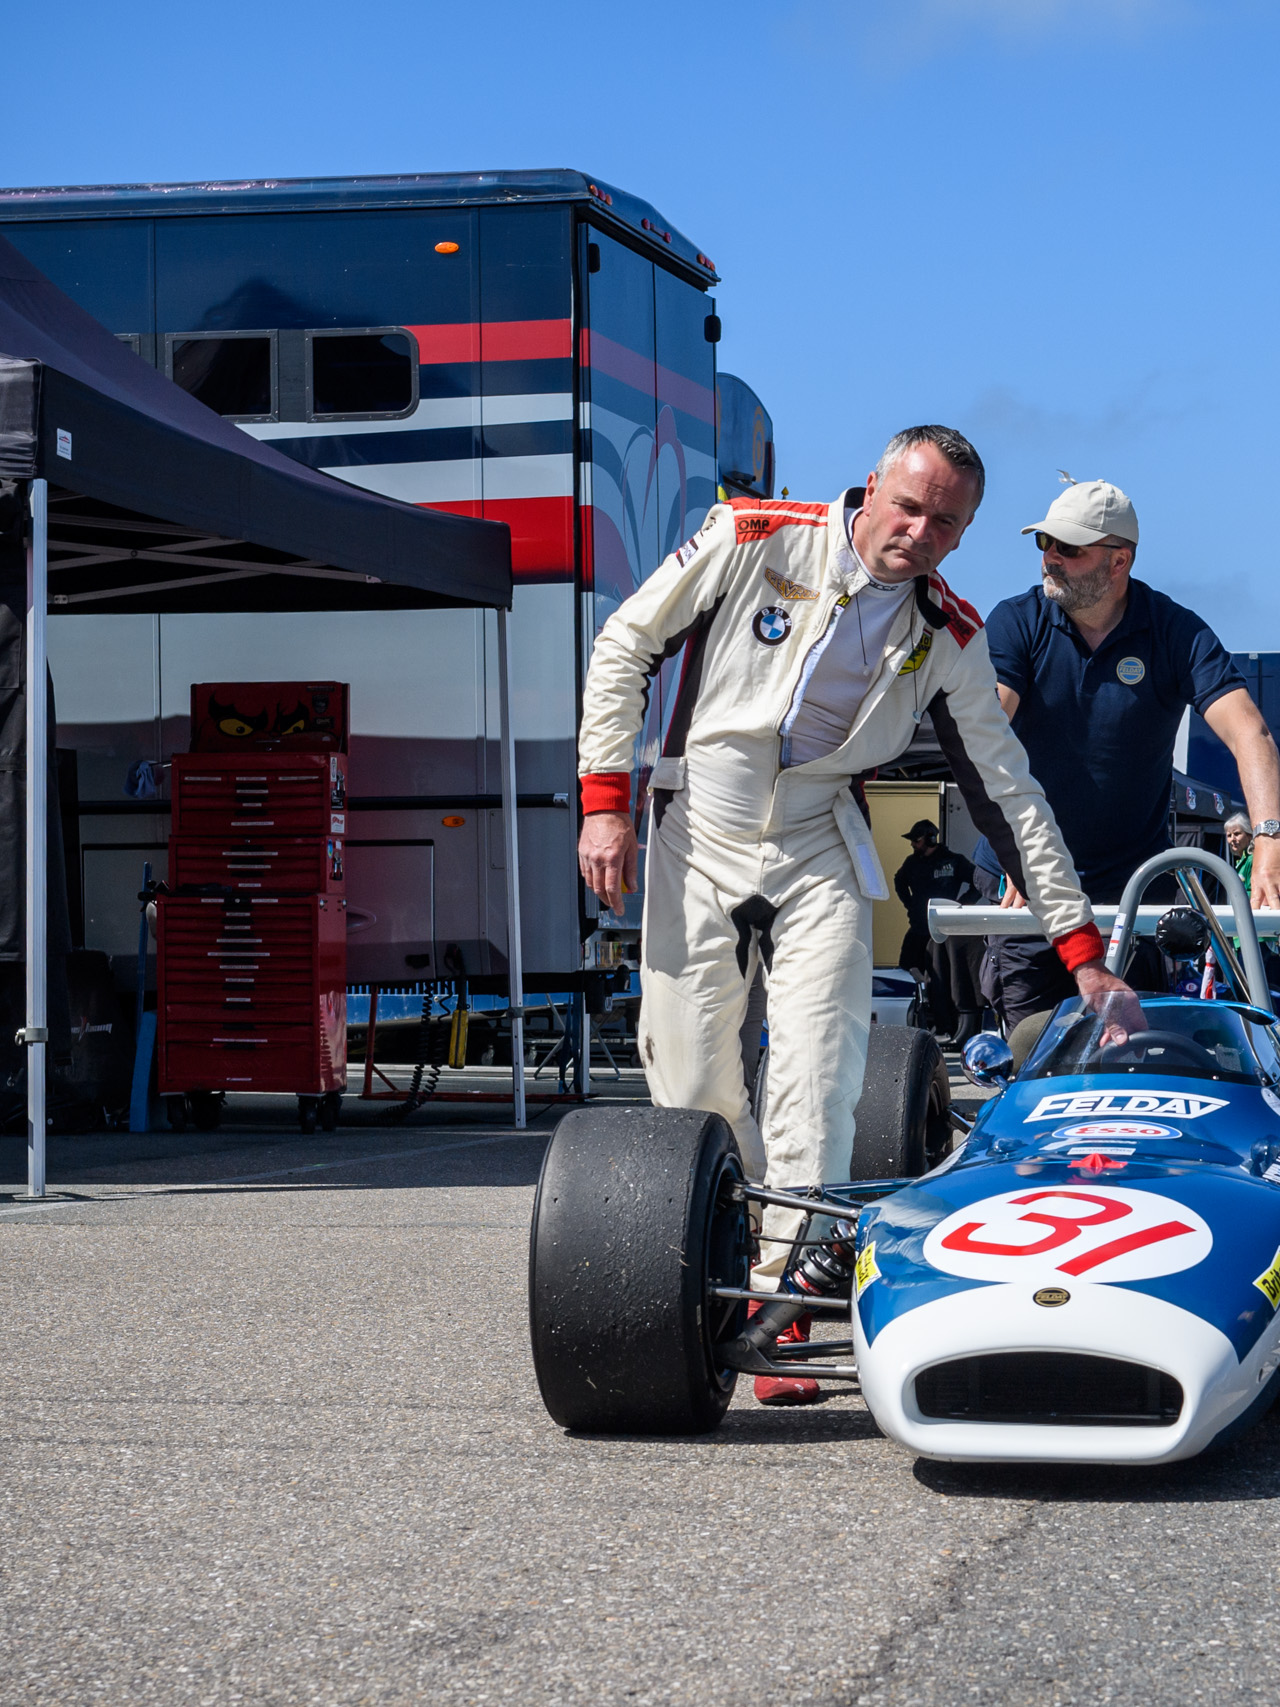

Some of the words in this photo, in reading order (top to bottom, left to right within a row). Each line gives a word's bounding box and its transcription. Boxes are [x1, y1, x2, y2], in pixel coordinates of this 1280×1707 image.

[737, 518, 770, 532] OMP
[761, 608, 792, 627] BMW
[1026, 1092, 1222, 1121] FELDAY
[941, 1191, 1197, 1277] 31
